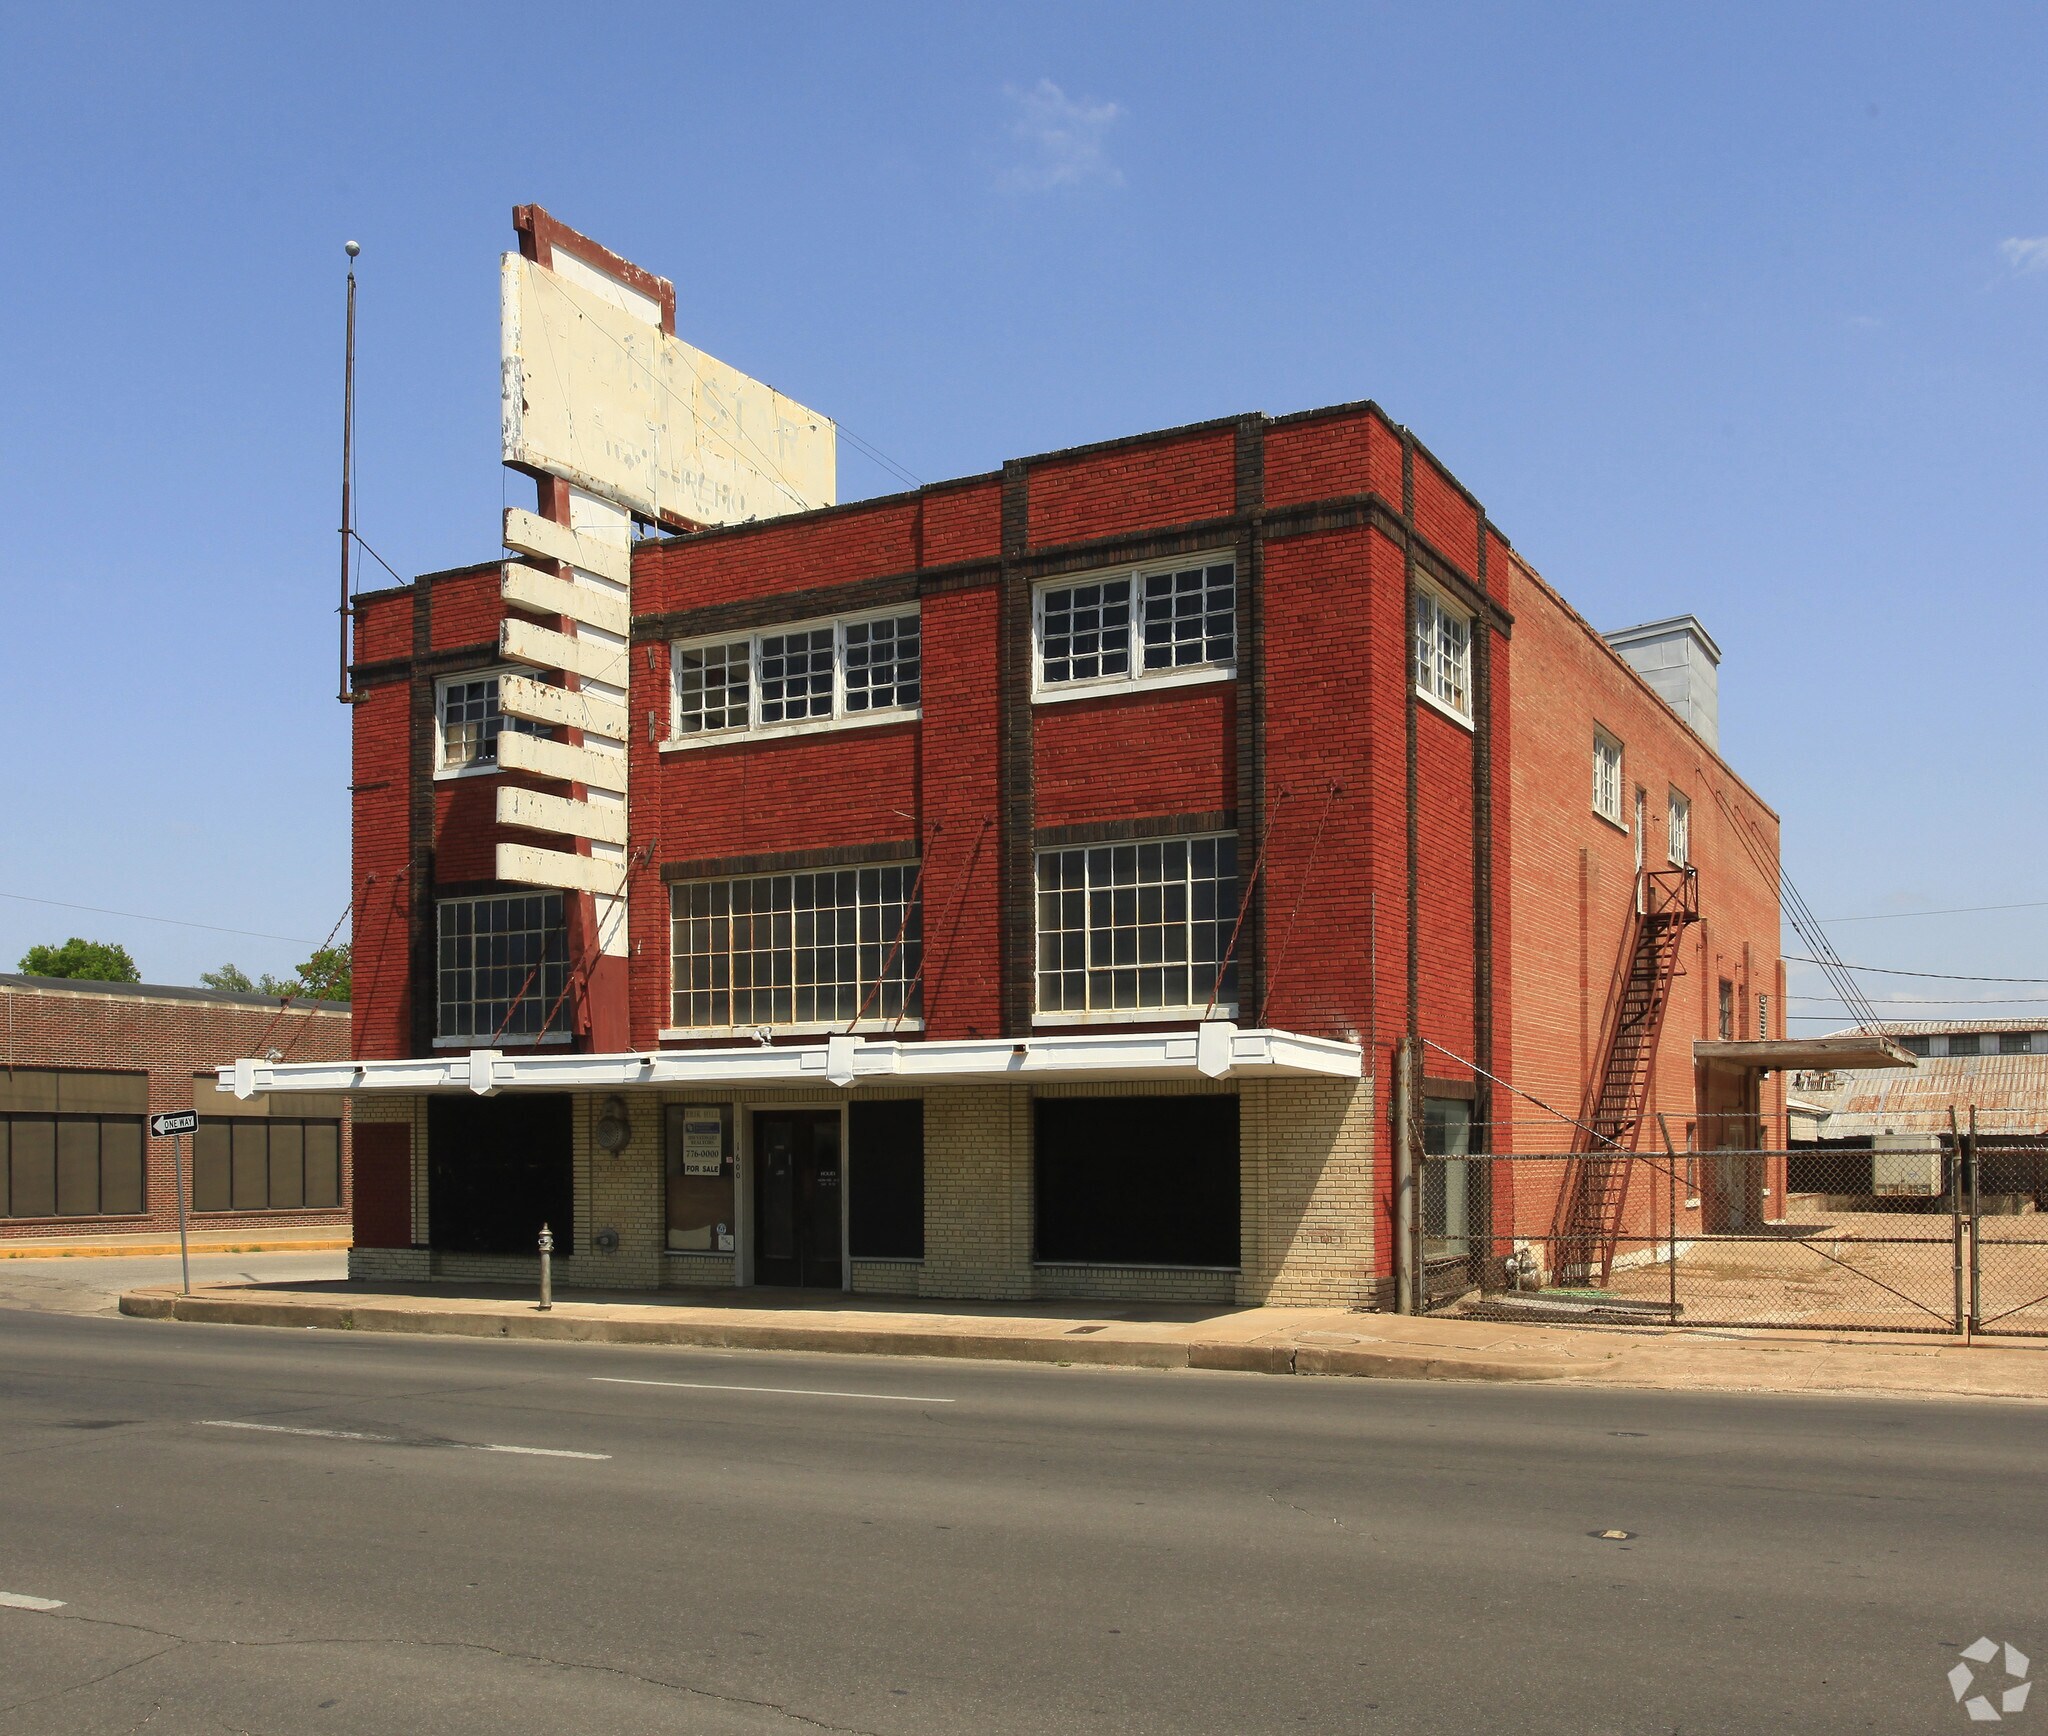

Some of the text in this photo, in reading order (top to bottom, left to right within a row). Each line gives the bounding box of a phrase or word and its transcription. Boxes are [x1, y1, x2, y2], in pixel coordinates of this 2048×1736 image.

[164, 1117, 193, 1129] ONE WAY
[686, 1149, 719, 1158] 776-0000
[702, 1165, 719, 1173] SALE
